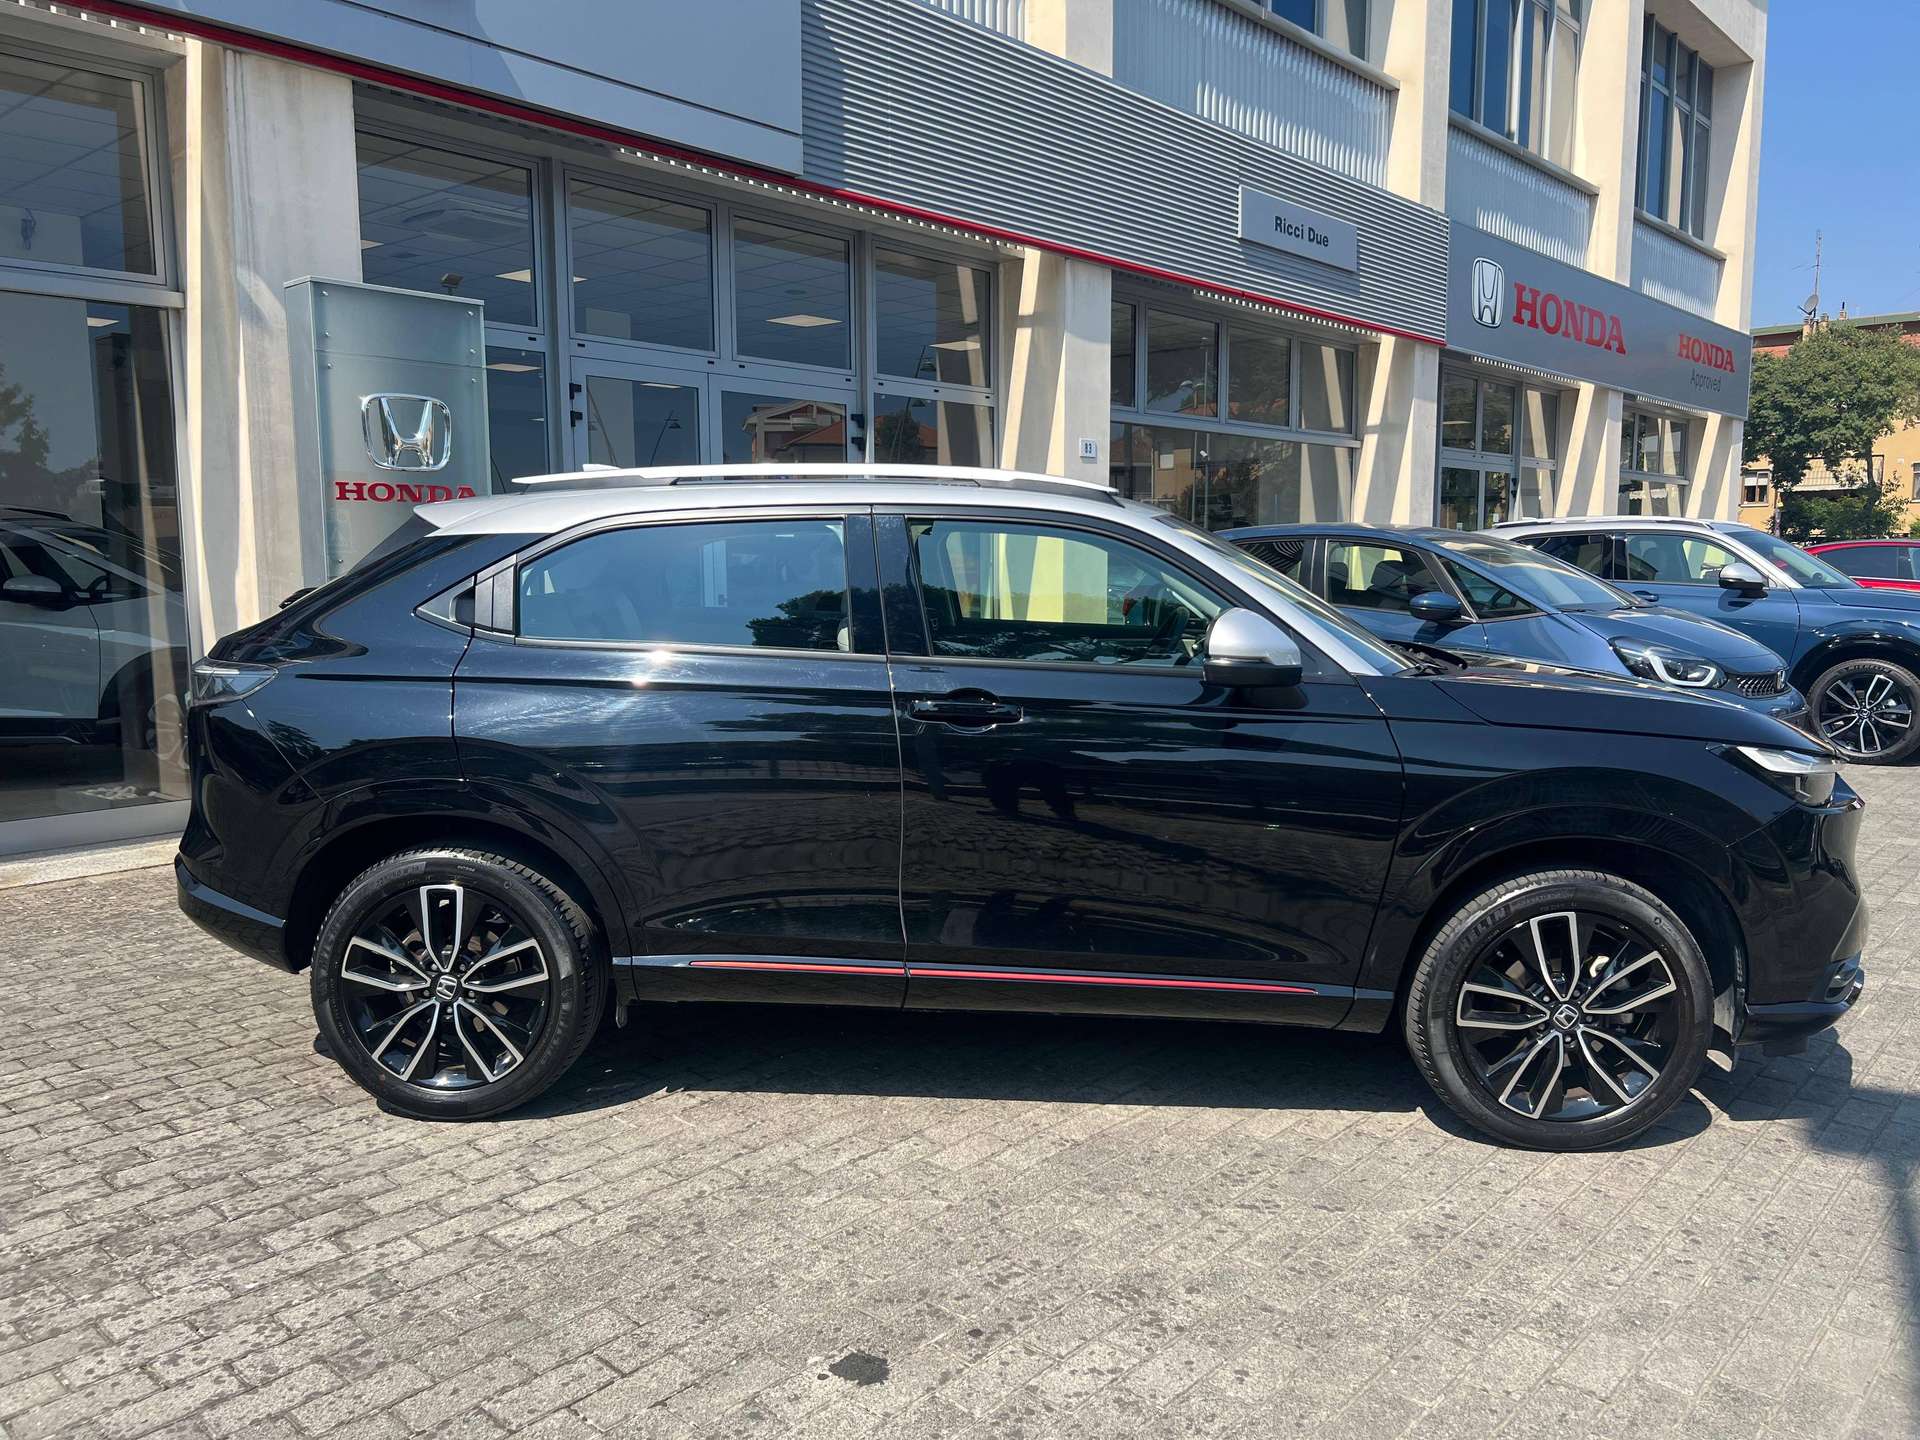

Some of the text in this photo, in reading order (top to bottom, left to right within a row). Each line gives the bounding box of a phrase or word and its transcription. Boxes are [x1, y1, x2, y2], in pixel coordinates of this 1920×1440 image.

[1274, 215, 1329, 247] Ricci Due
[1512, 281, 1626, 355] HONDA
[1677, 334, 1736, 373] HONDA
[1689, 368, 1721, 393] Approved
[335, 481, 477, 503] HONDA
